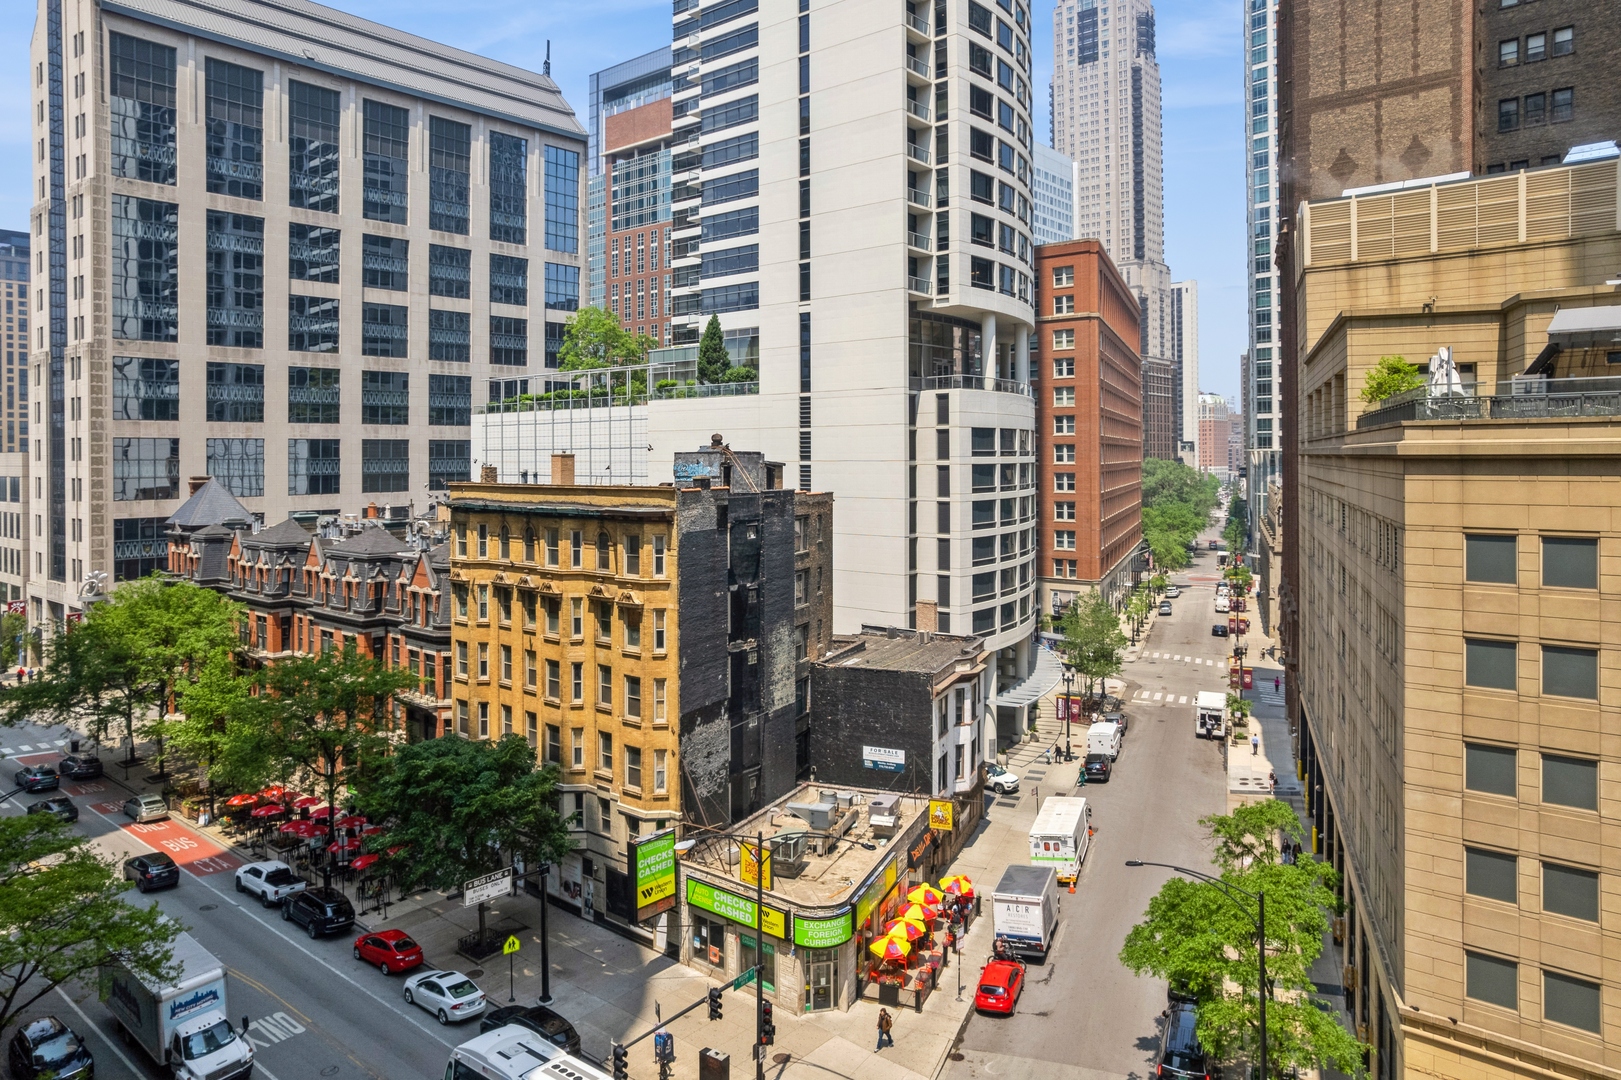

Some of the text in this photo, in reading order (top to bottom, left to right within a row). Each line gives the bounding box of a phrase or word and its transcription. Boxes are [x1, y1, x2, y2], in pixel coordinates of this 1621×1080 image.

[161, 837, 198, 852] BUS
[193, 856, 233, 872] CTA
[638, 848, 673, 868] CHECKS
[638, 860, 673, 878] CASHED
[474, 872, 503, 886] BUS LANE
[654, 880, 672, 890] Western
[473, 885, 488, 894] BUSES
[654, 886, 667, 895] Union
[714, 891, 752, 912] CHECKS
[714, 902, 752, 923] CASHED
[804, 917, 845, 929] EXCHANGE
[804, 934, 846, 946] CURRENCY
[808, 928, 842, 938] FOREIGN
[236, 1011, 306, 1053] ONLY
